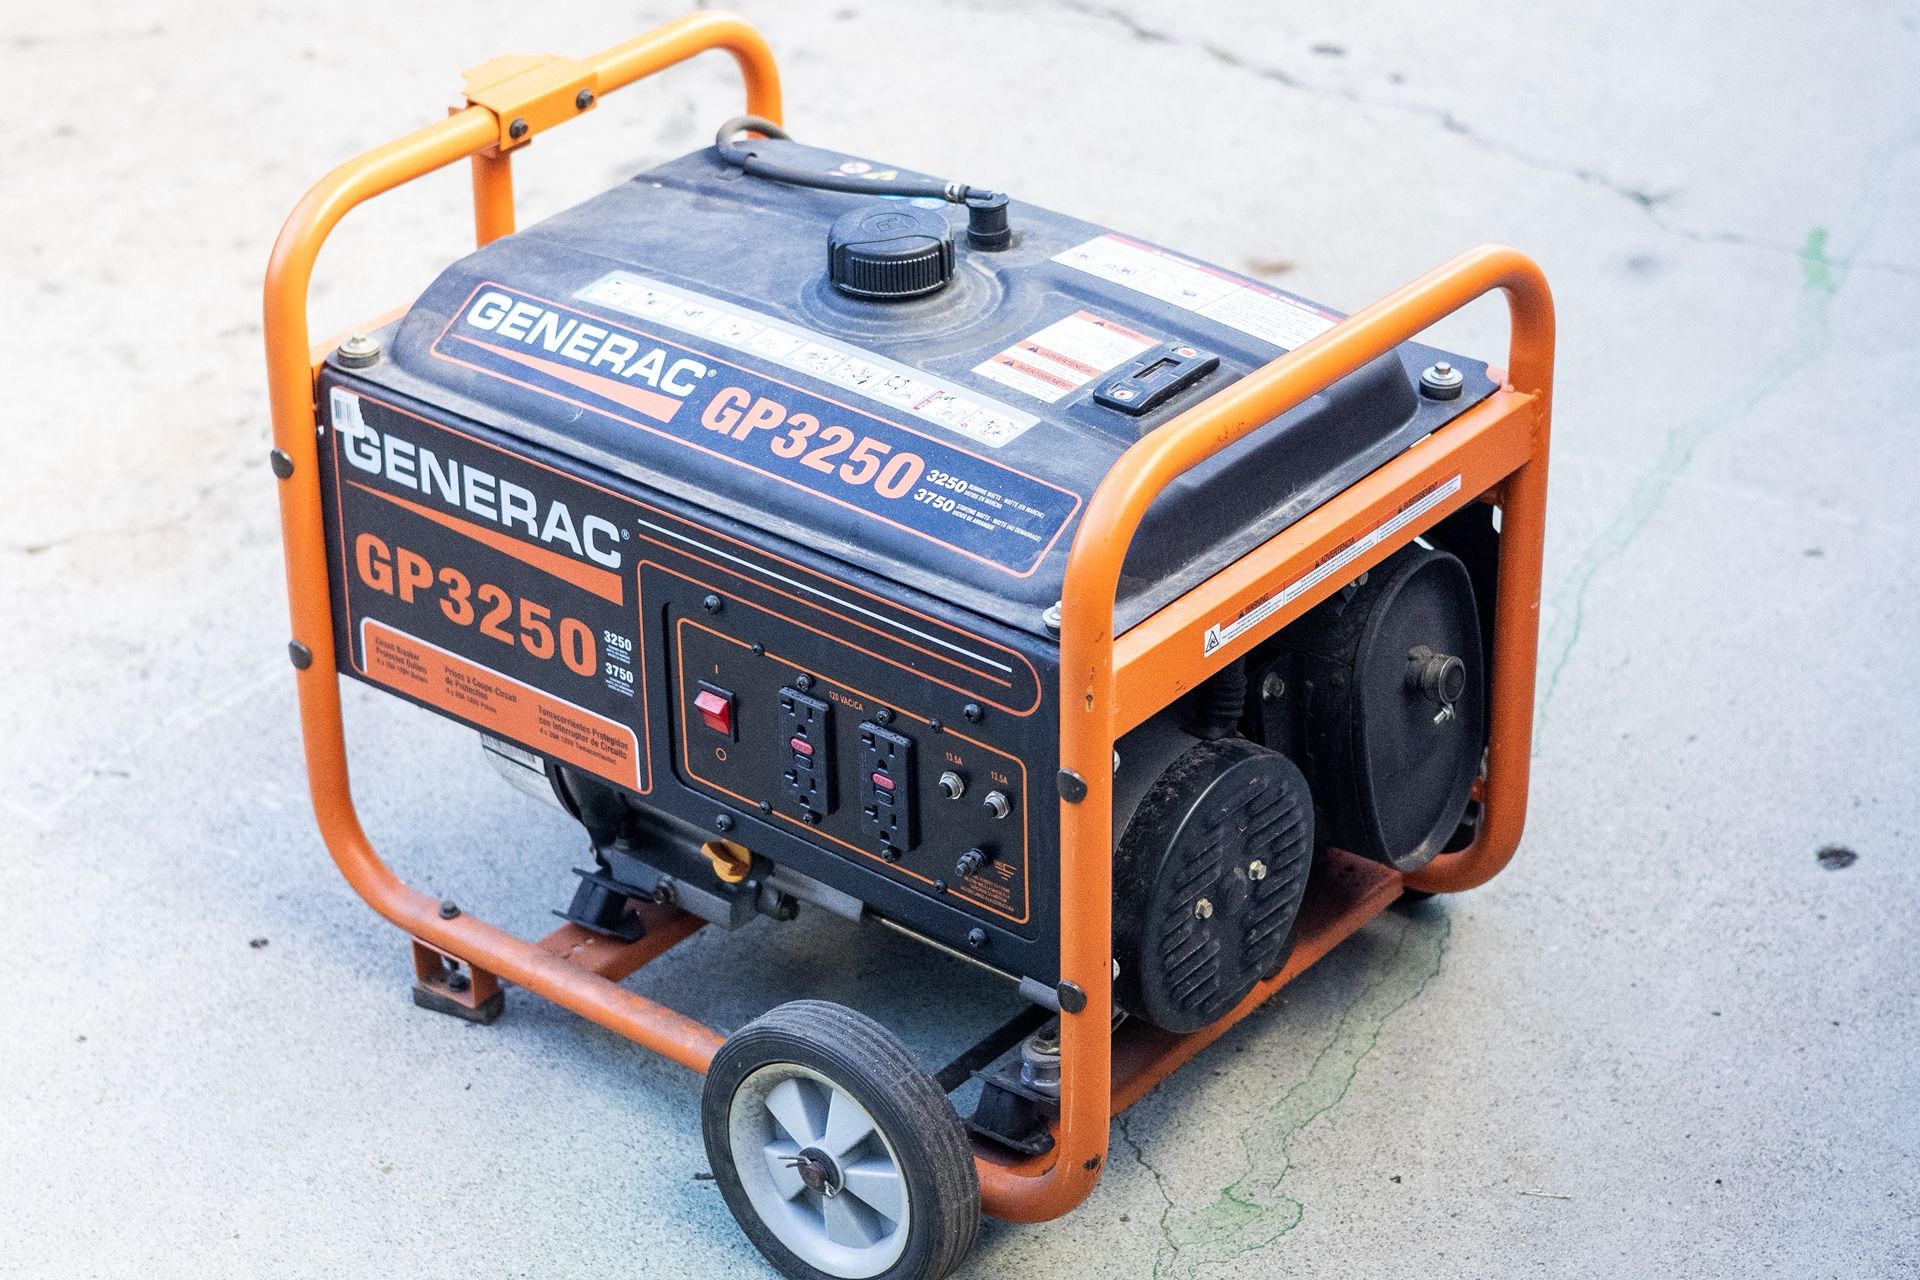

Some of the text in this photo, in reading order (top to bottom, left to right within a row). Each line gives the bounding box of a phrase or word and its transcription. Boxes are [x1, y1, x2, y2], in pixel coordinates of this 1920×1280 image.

[700, 386, 925, 499] GP3250
[926, 469, 968, 493] 3250
[914, 488, 955, 512] 3750
[355, 532, 597, 677] GP3250
[604, 630, 632, 652] 3250
[605, 662, 634, 683] 3750
[828, 690, 839, 703] 120
[945, 752, 963, 766] 13.5A
[990, 770, 1009, 785] 13.5A
